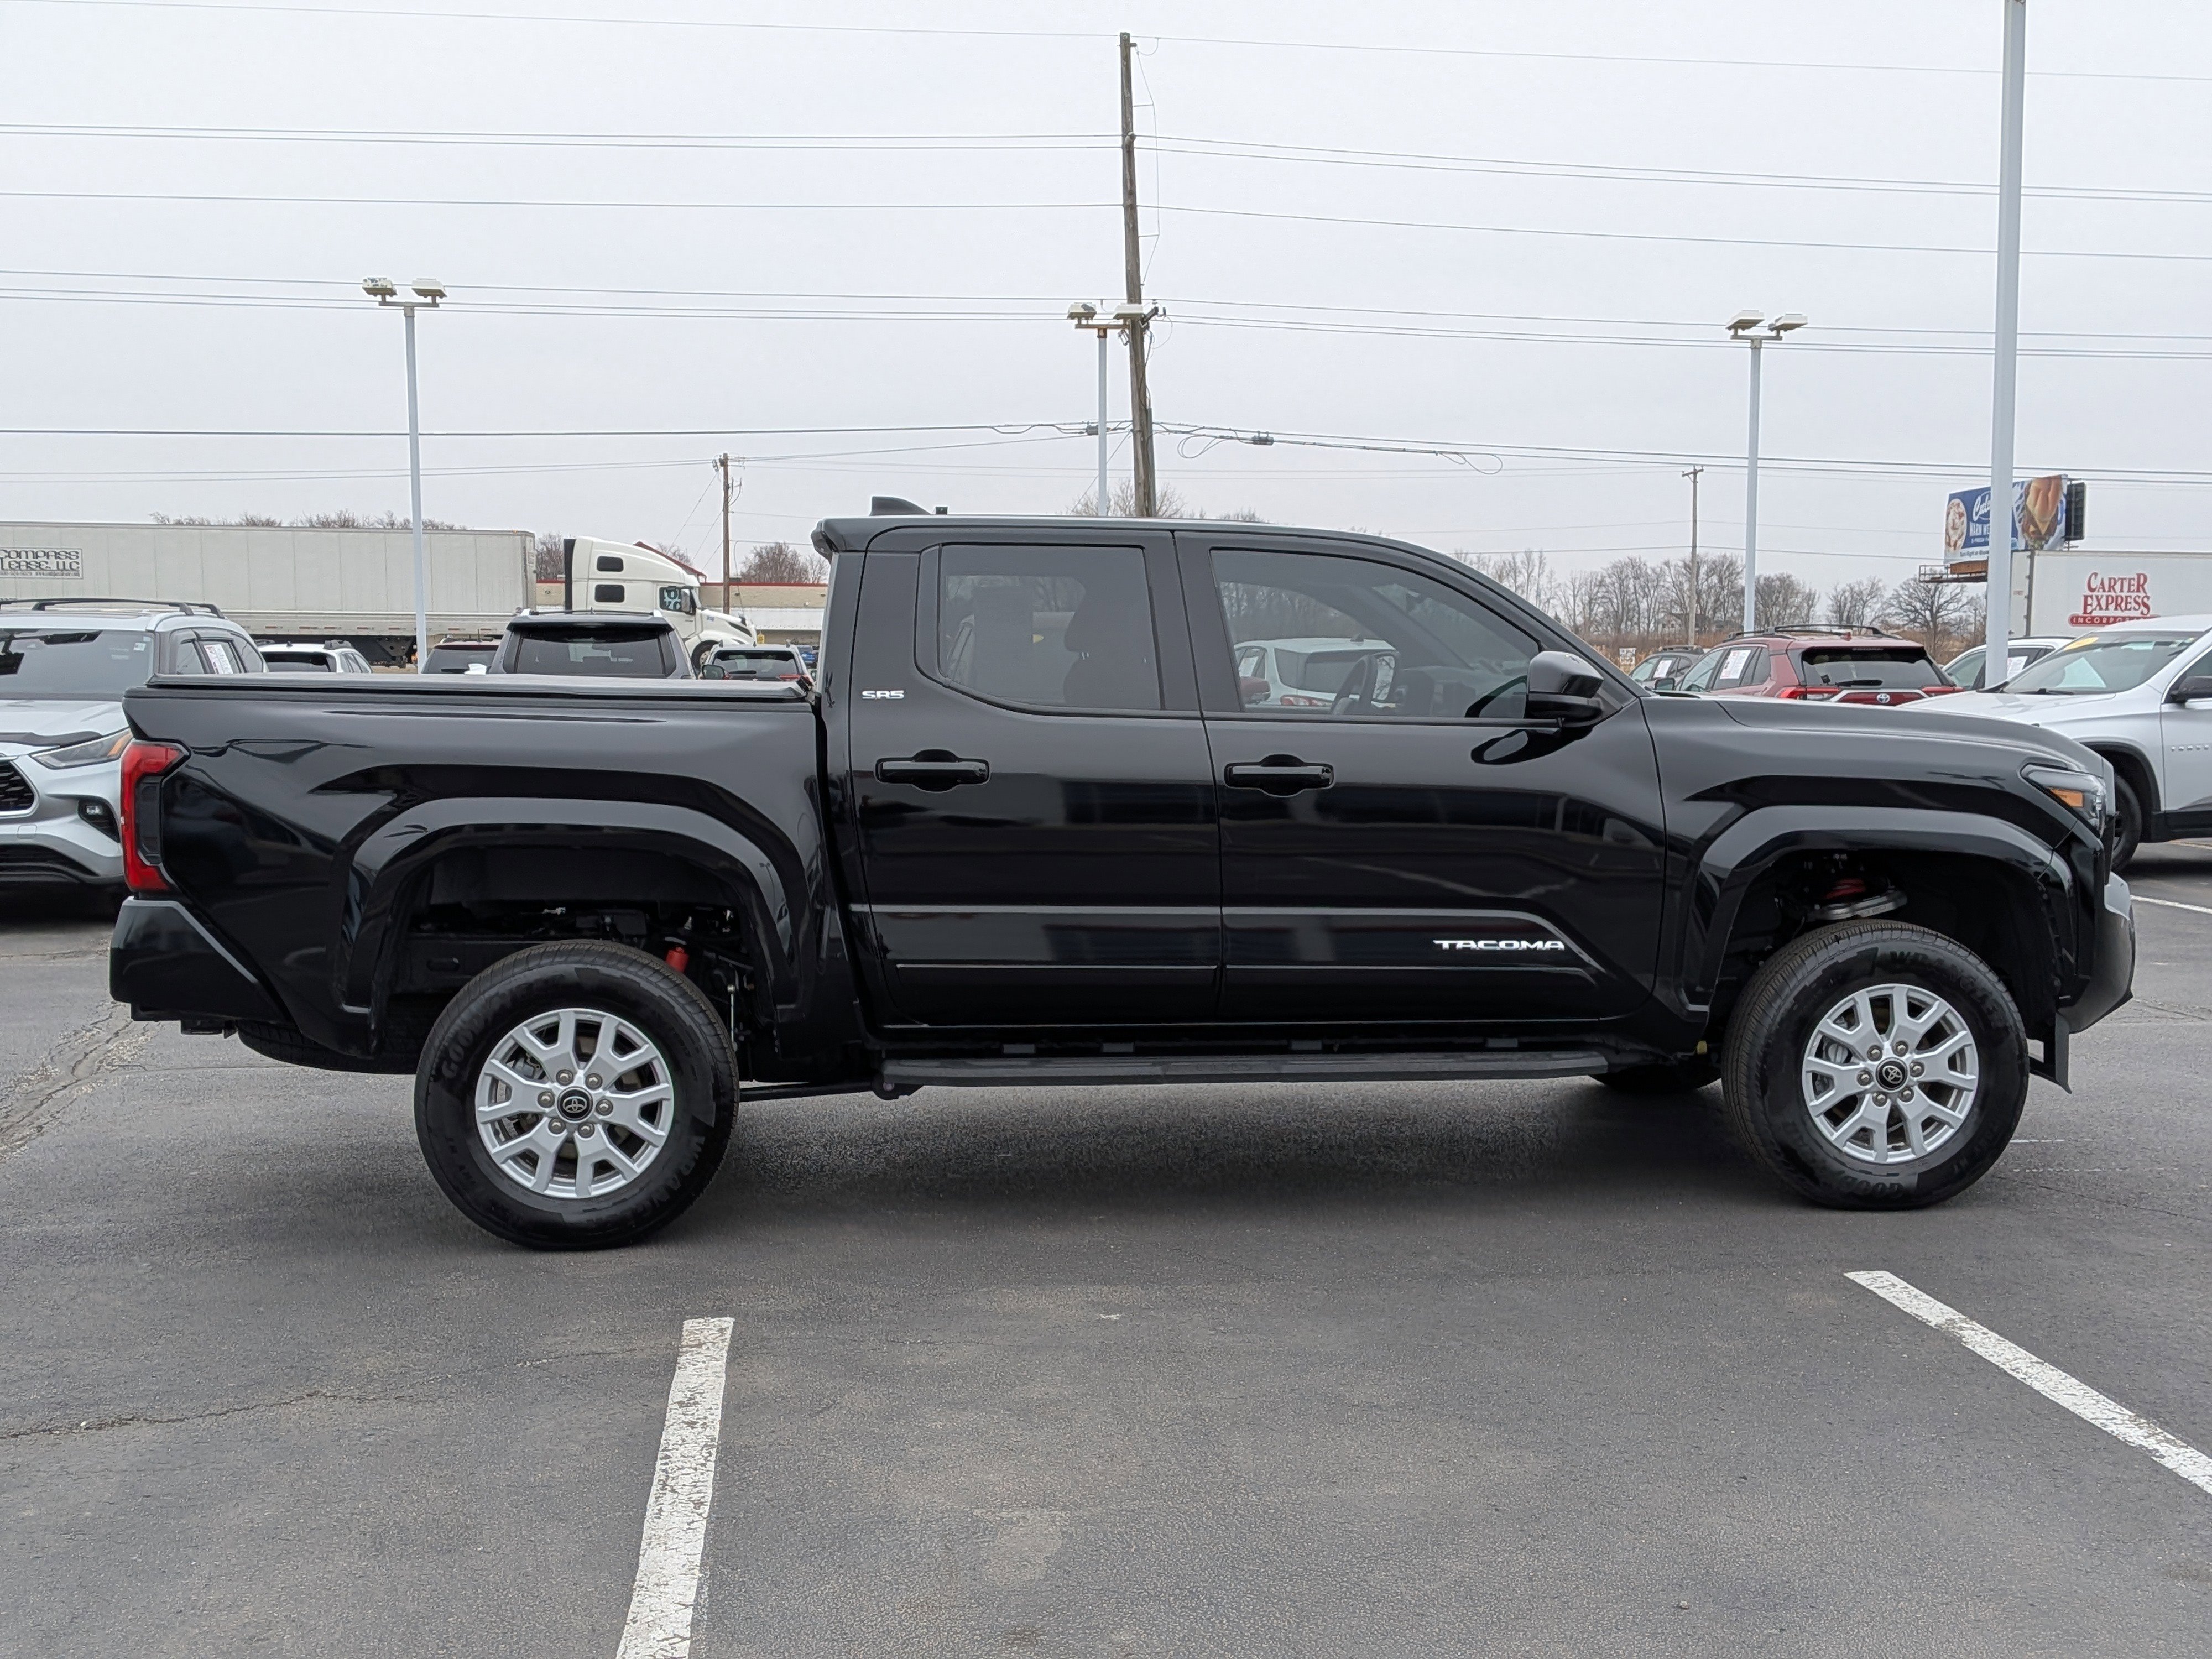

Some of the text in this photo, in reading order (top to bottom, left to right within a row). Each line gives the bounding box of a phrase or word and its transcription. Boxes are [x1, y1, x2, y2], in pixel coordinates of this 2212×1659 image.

[56, 561, 80, 571] LLC
[2087, 572, 2147, 594] CARTER
[2083, 594, 2151, 615] EXPRESS
[862, 690, 904, 700] SR5
[1433, 940, 1565, 951] TACOMA
